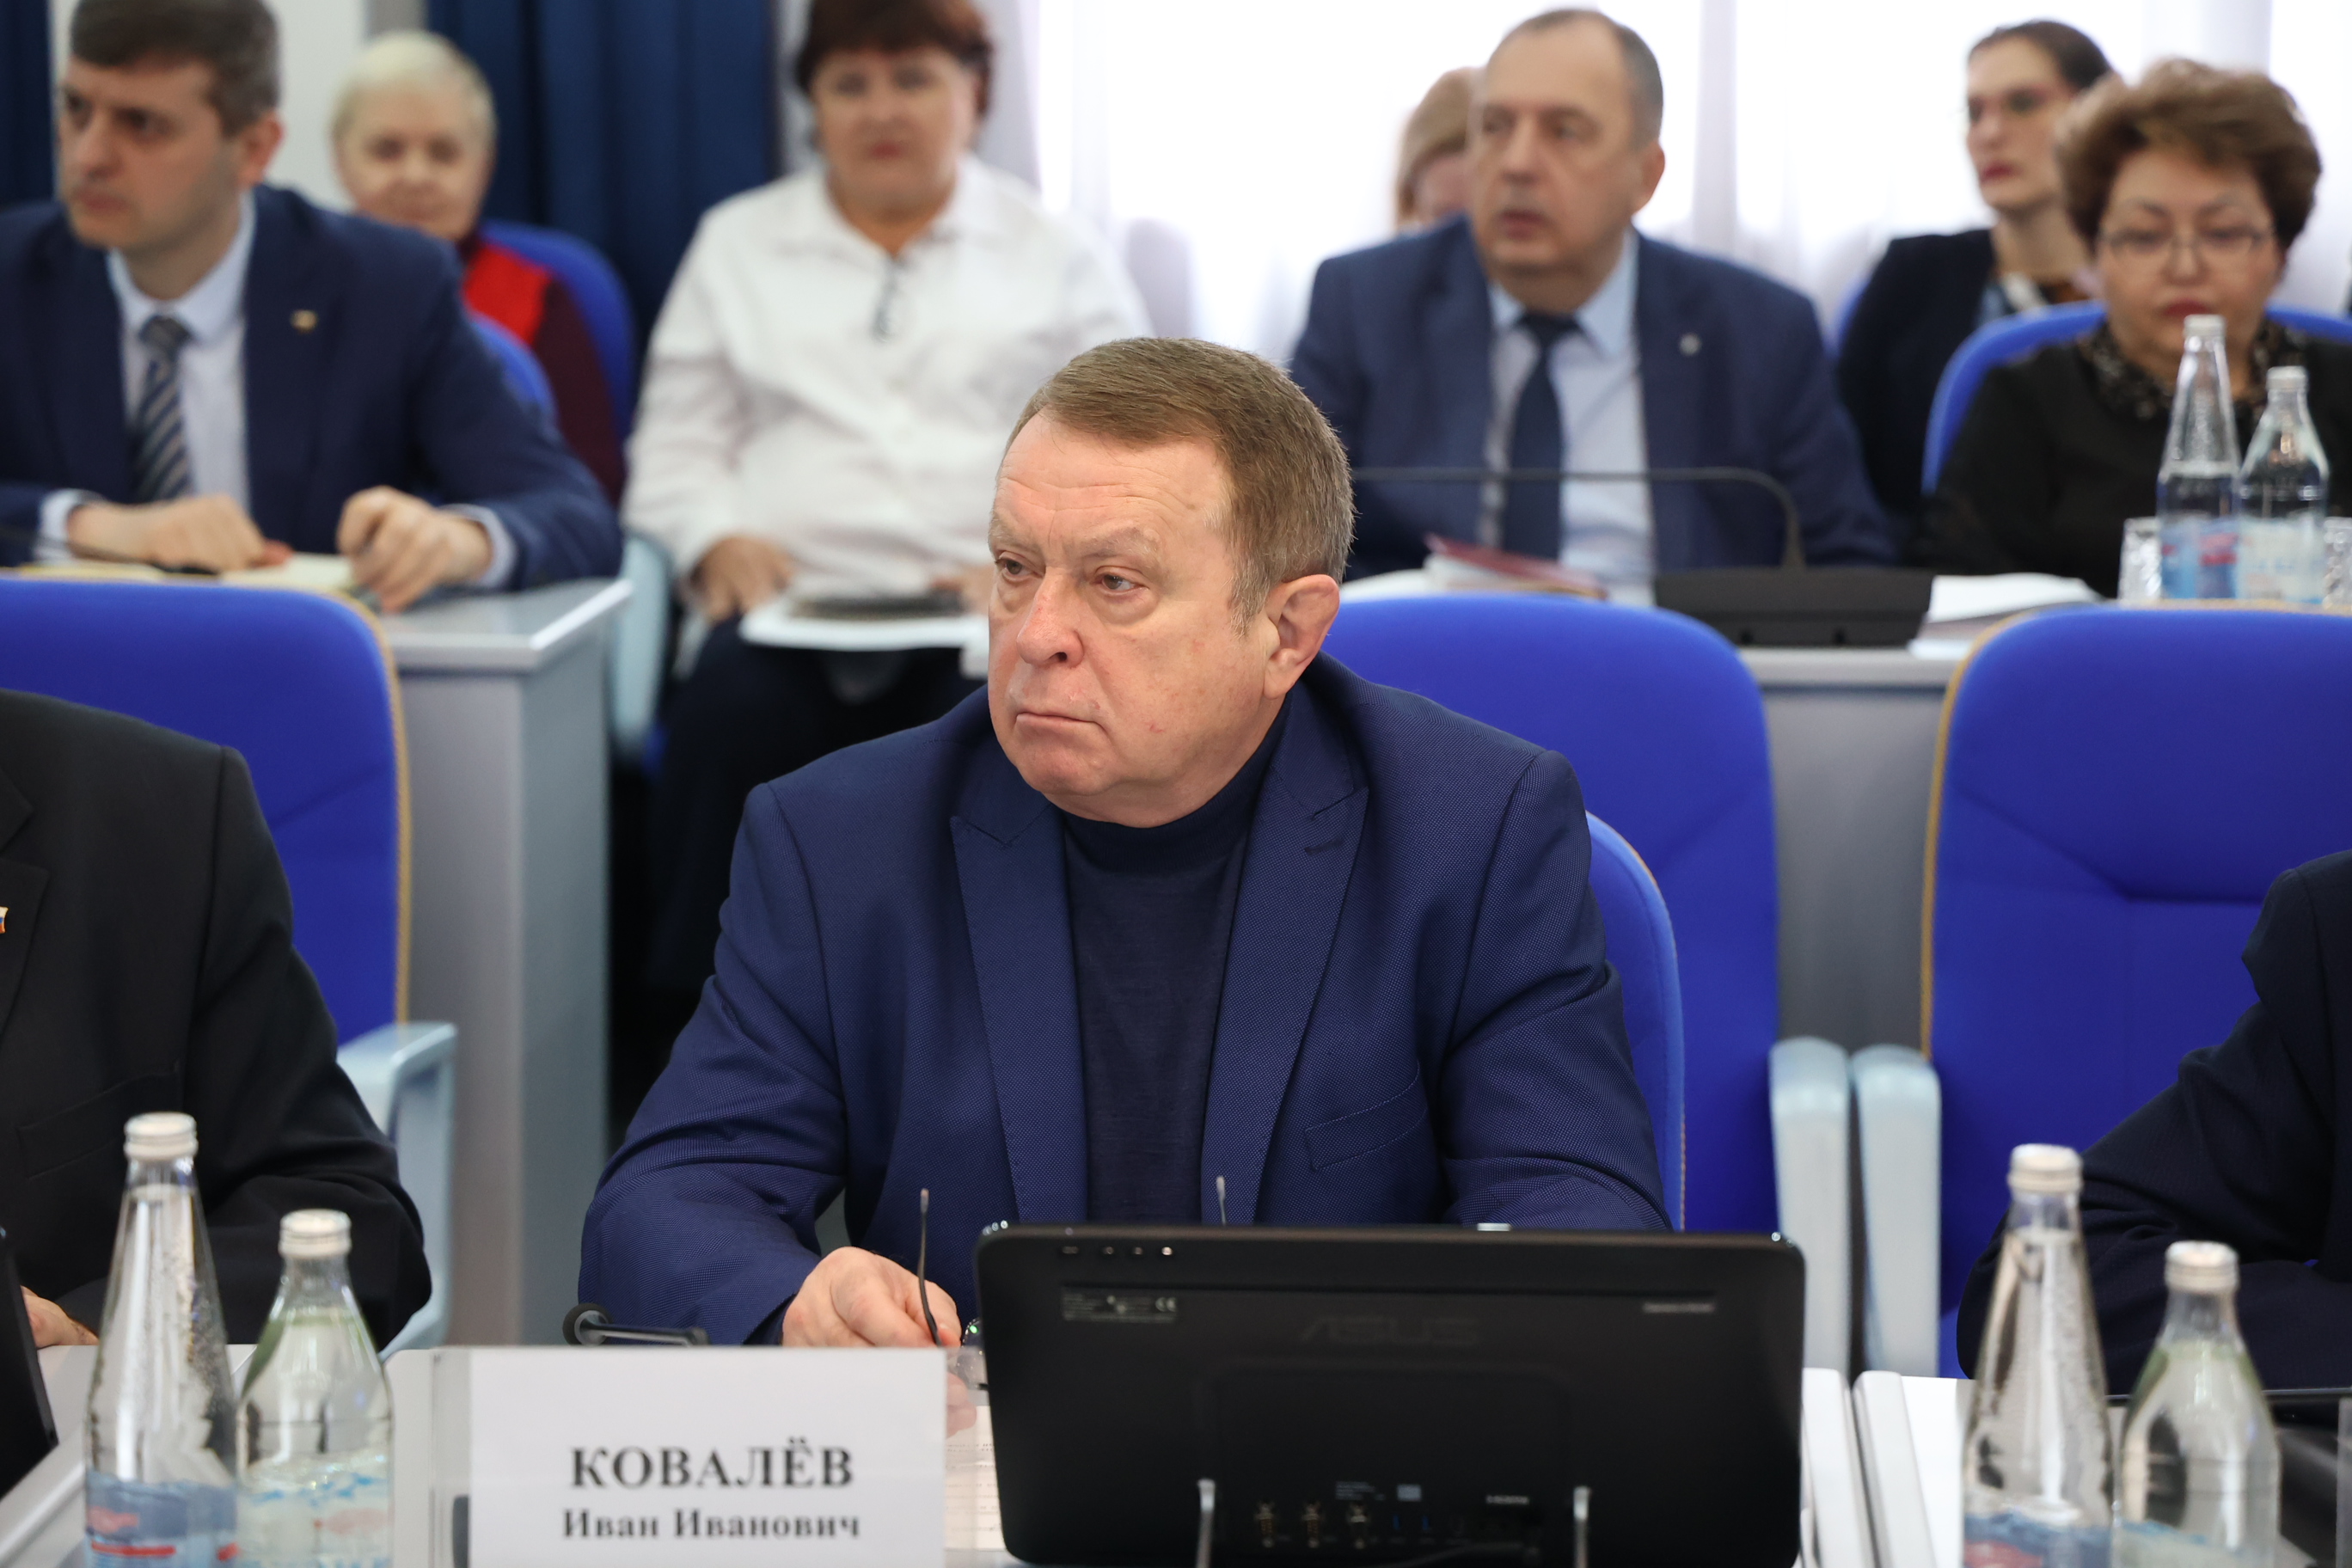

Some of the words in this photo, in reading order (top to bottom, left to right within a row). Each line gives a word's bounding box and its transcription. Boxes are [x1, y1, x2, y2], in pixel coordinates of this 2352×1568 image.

[1298, 1315, 1480, 1346] ASUS
[571, 1436, 854, 1489] КОВАЛЁВ
[563, 1509, 659, 1539] Иван
[675, 1509, 860, 1539] Иванович
